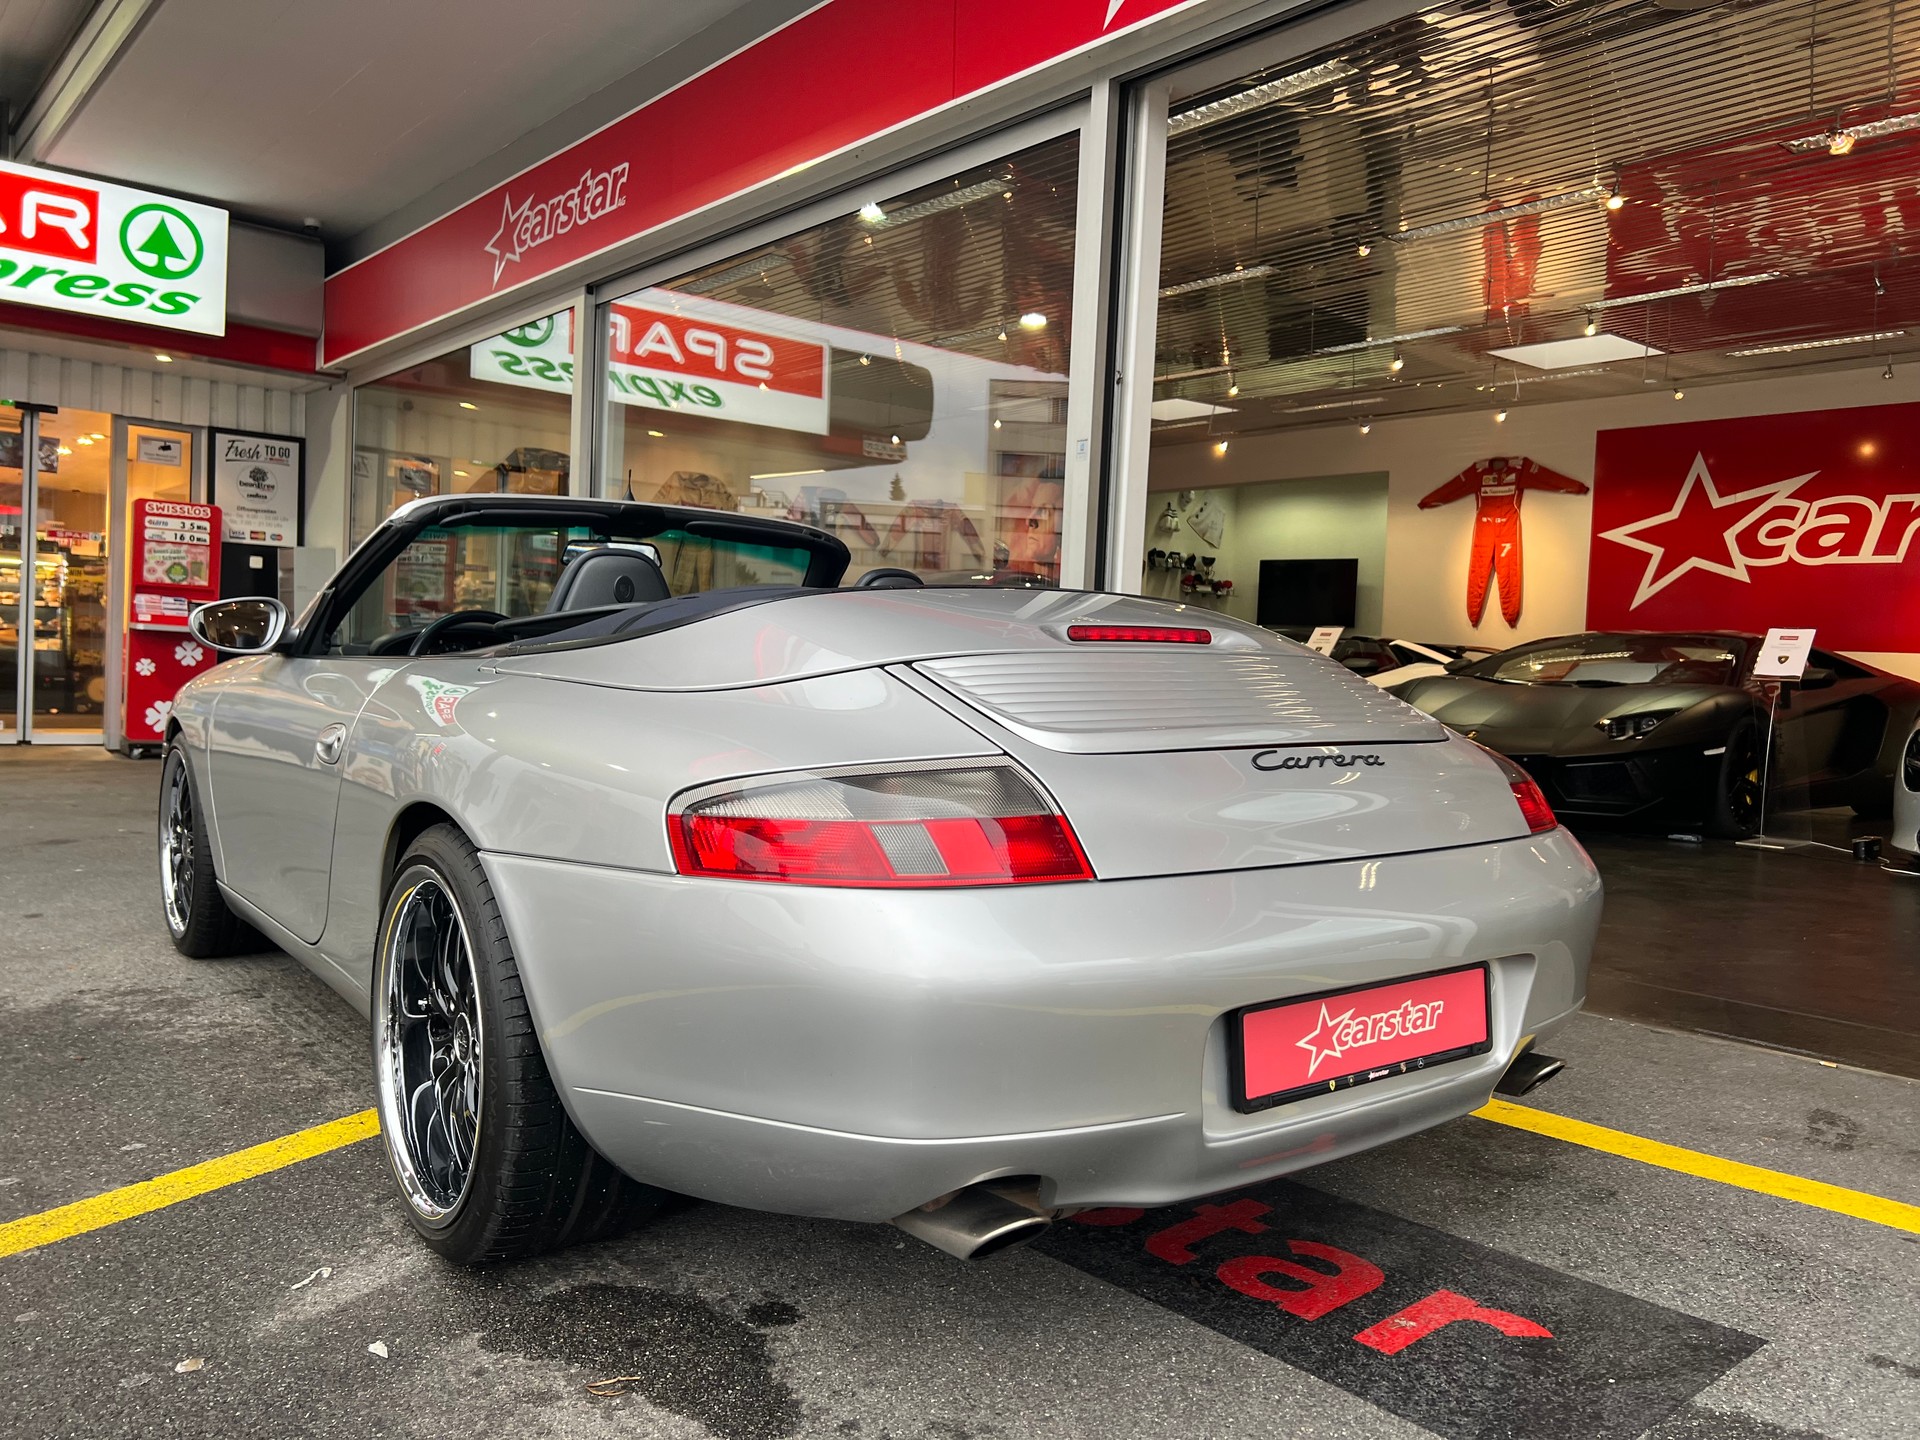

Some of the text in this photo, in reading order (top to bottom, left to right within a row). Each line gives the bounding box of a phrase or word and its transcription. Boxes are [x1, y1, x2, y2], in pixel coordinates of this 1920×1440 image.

[514, 162, 630, 254] carstar
[225, 440, 260, 460] Fresh
[265, 445, 276, 457] TO
[278, 447, 290, 458] GO
[147, 503, 210, 518] SWISSLOS
[56, 531, 90, 540] SPAR
[1500, 543, 1512, 557] 7
[1251, 750, 1385, 771] Carrera
[1333, 1000, 1444, 1051] carstar
[1068, 1198, 1554, 1356] tar
